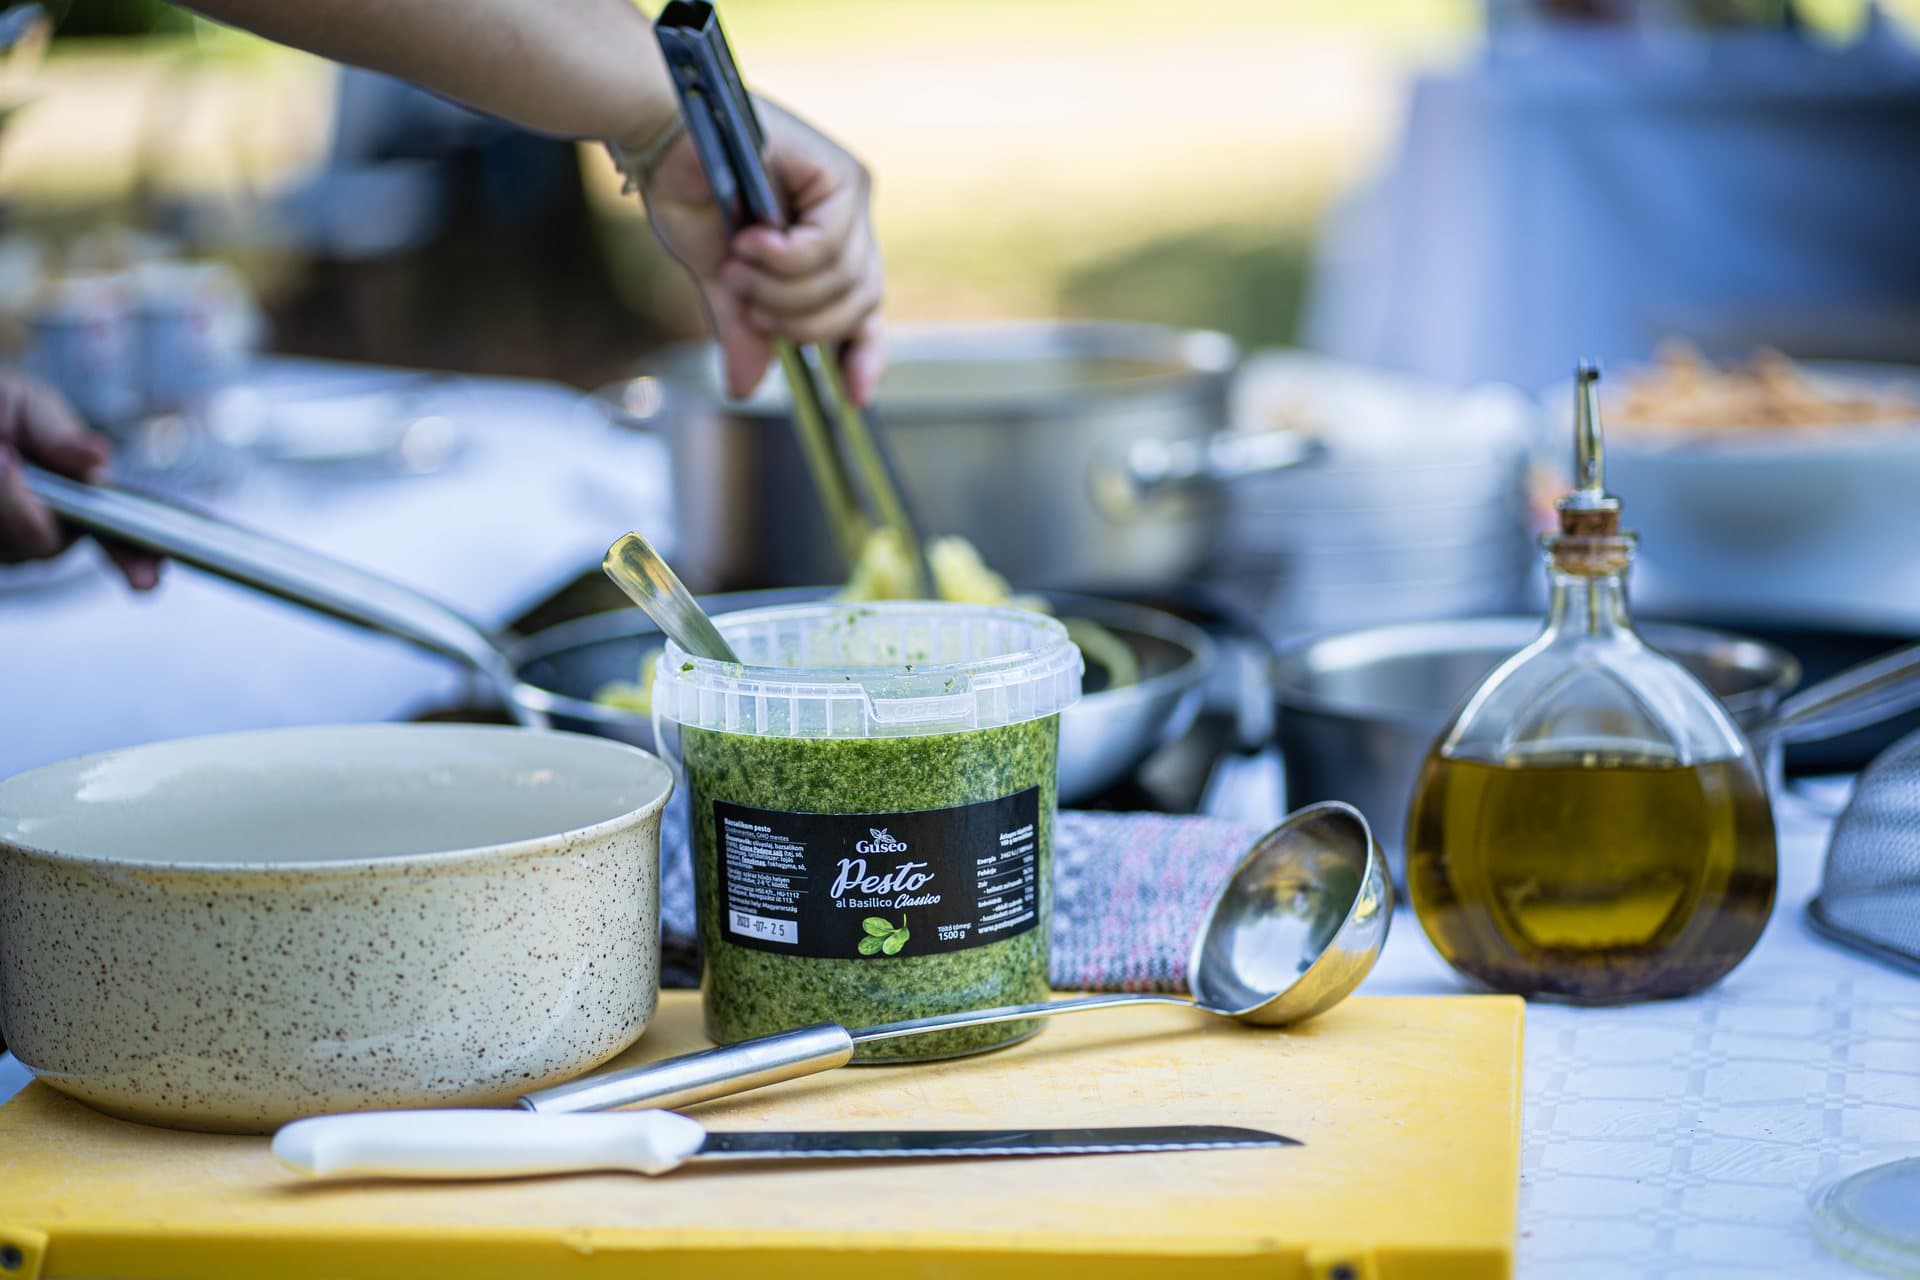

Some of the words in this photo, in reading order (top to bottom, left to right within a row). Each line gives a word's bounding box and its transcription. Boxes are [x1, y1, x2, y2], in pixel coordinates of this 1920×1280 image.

[754, 824, 772, 832] pesto
[856, 840, 908, 854] Guseo
[830, 858, 935, 899] Pesto
[836, 898, 847, 908] al
[849, 897, 893, 908] Basilico
[894, 893, 941, 909] Classico
[938, 930, 959, 942] 1500
[959, 930, 966, 940] g
